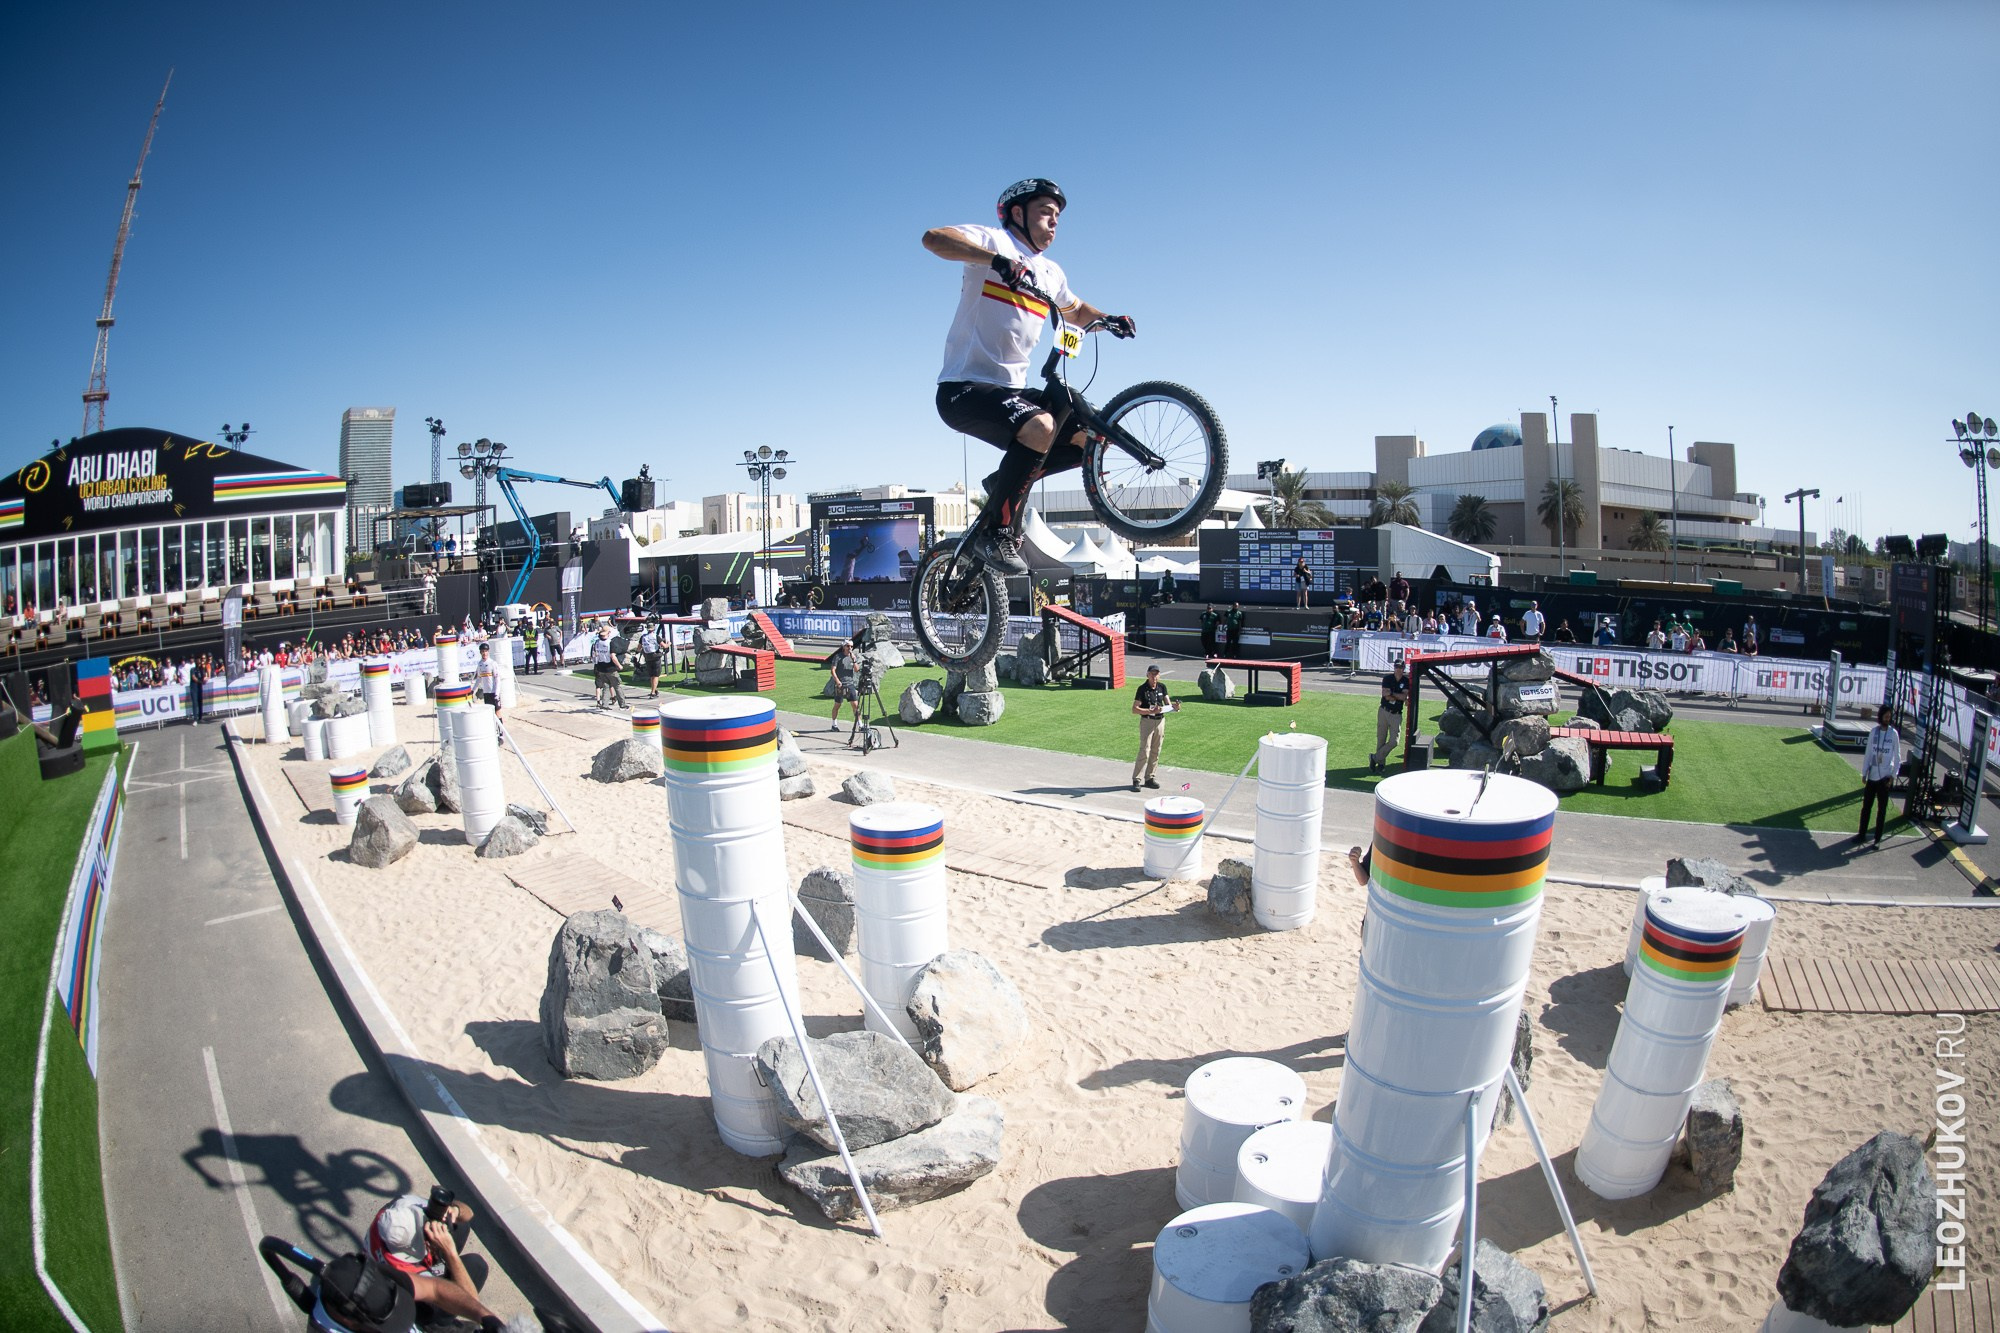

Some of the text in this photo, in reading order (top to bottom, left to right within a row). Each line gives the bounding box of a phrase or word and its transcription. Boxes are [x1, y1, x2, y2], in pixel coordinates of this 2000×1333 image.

[67, 448, 158, 486] ABU DHABI
[79, 473, 168, 499] UCI URBAN CYCLING
[83, 488, 173, 511] WORLD CHAMPIONSHIPS
[831, 505, 845, 514] UCI
[1242, 531, 1258, 540] UCI
[838, 597, 868, 606] ABU DHABI
[784, 619, 840, 632] SHIMANO
[1612, 658, 1704, 683] TISSOT
[1530, 687, 1553, 695] TISSOT
[141, 695, 176, 717] UCI
[1856, 738, 1868, 746] UC
[94, 837, 108, 892] UCI
